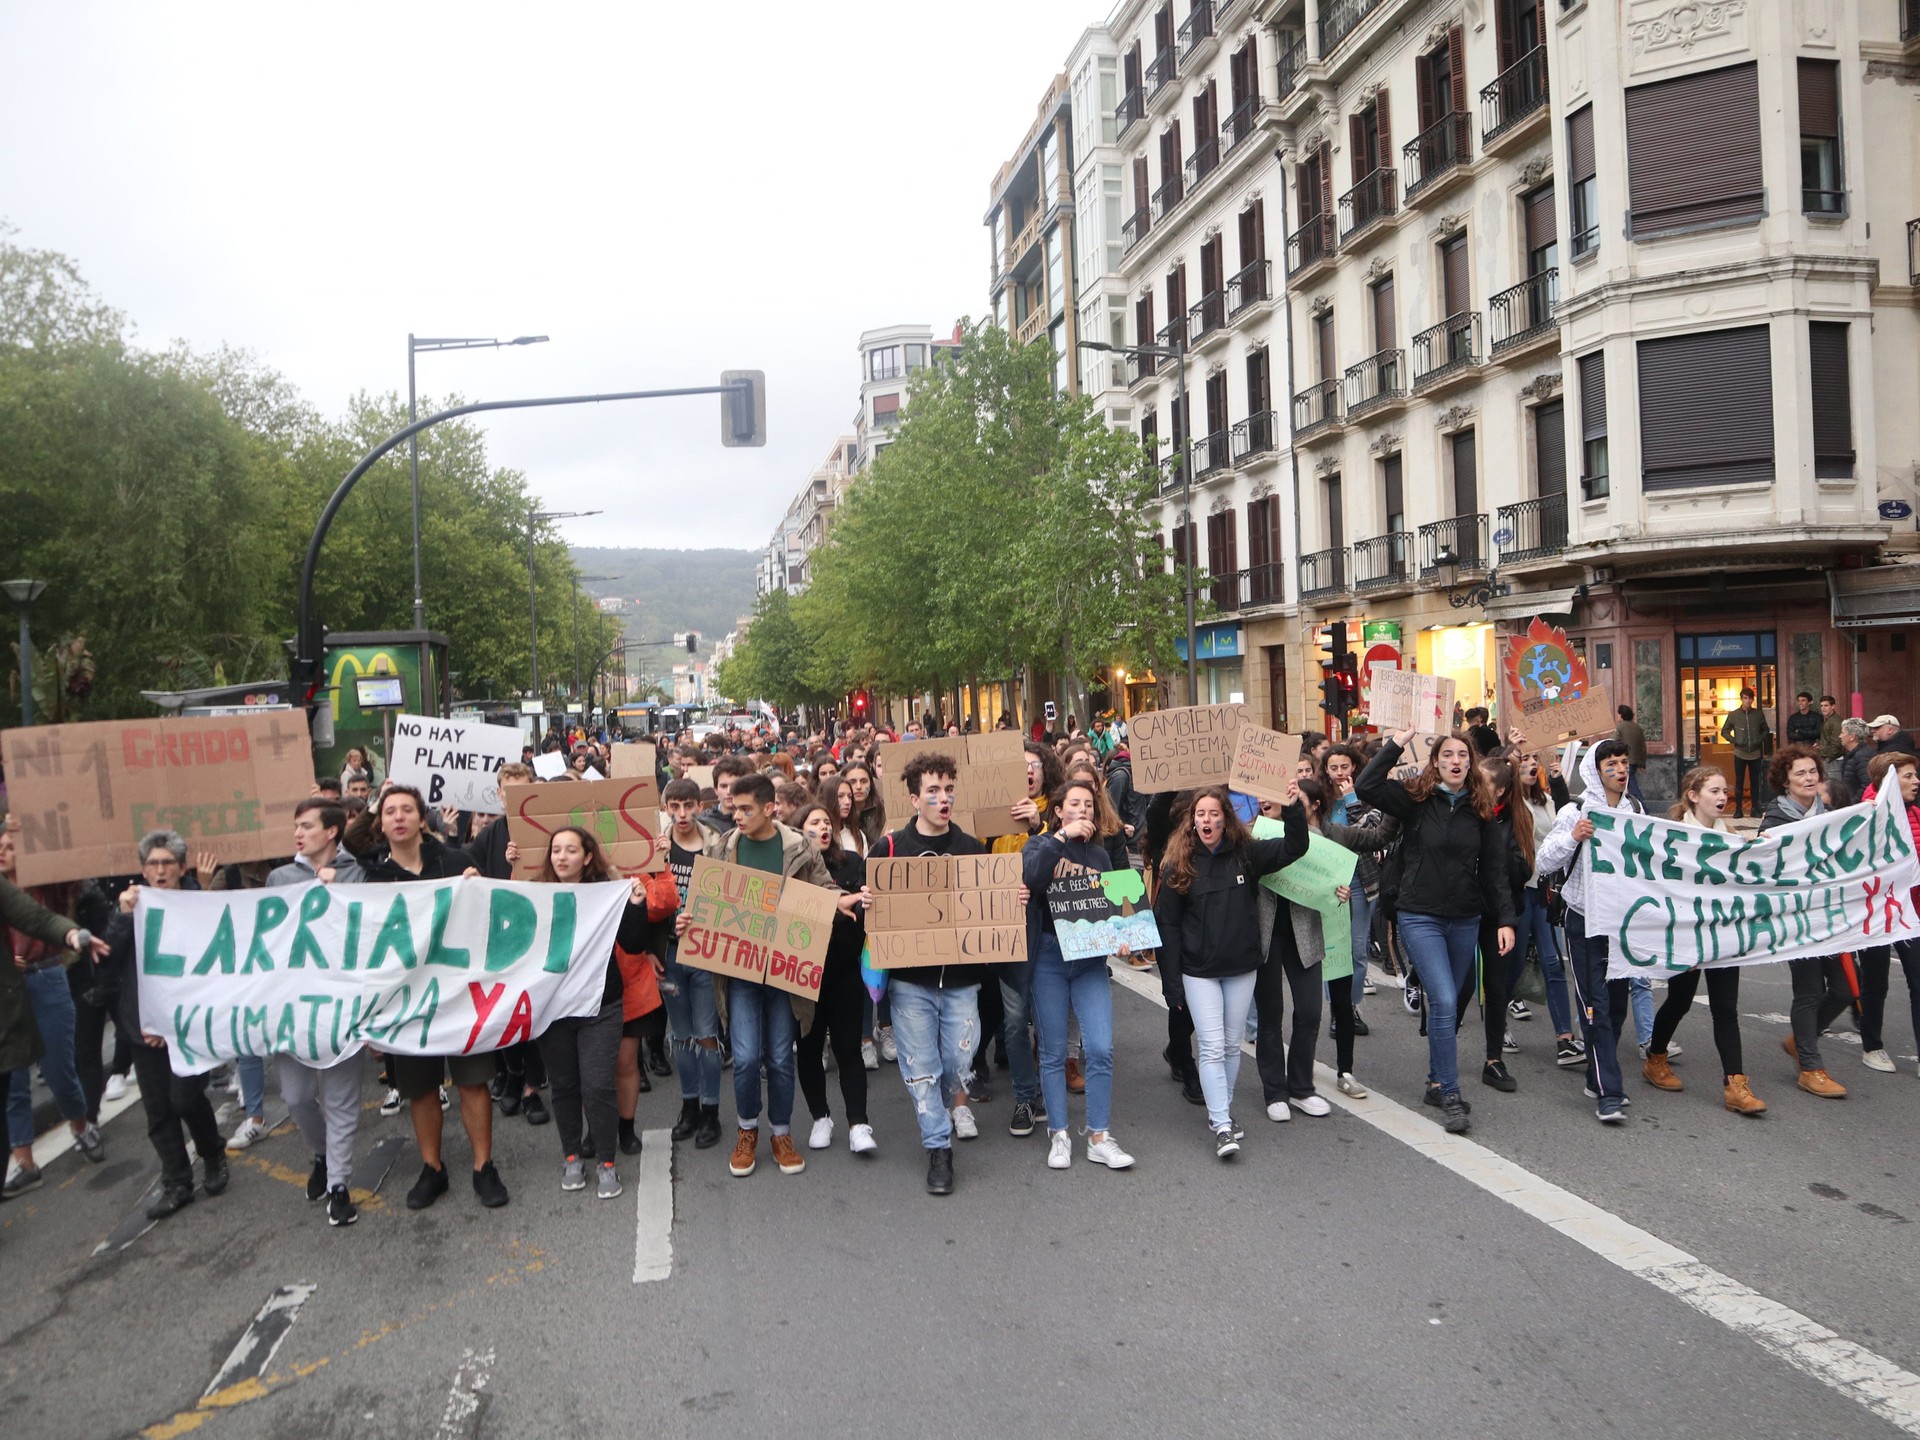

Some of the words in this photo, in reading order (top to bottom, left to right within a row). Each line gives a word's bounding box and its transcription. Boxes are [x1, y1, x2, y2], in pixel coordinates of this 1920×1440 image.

[1520, 701, 1584, 731] IRTENBIDE
[398, 722, 422, 736] NO
[429, 726, 466, 743] HAY
[1242, 727, 1281, 752] GURE
[11, 729, 63, 778] Ni
[121, 728, 250, 770] GRADO
[415, 747, 506, 773] PLANETA
[1140, 745, 1158, 761] EL
[1238, 754, 1276, 775] SUTAN
[1241, 744, 1266, 758] etxea
[1144, 762, 1170, 784] NO
[1178, 760, 1198, 776] EL
[428, 774, 445, 803] B
[20, 801, 73, 855] Ni
[1588, 800, 1911, 886] EMERGENCIA
[699, 866, 781, 913] GURE
[874, 856, 1018, 891] CAMBIEMOS
[1046, 881, 1067, 895] SAVE
[1069, 879, 1090, 892] BEES
[692, 896, 779, 943] ETXEA
[874, 896, 903, 929] EL
[926, 890, 1025, 924] SISTEMA
[1048, 900, 1071, 914] PLANT
[1862, 876, 1912, 935] YA
[143, 884, 577, 976] LARRIALDI
[684, 927, 768, 973] SUTAN
[770, 950, 823, 990] DAGO
[875, 932, 906, 963] NO
[915, 931, 951, 956] EL
[462, 981, 531, 1055] YA
